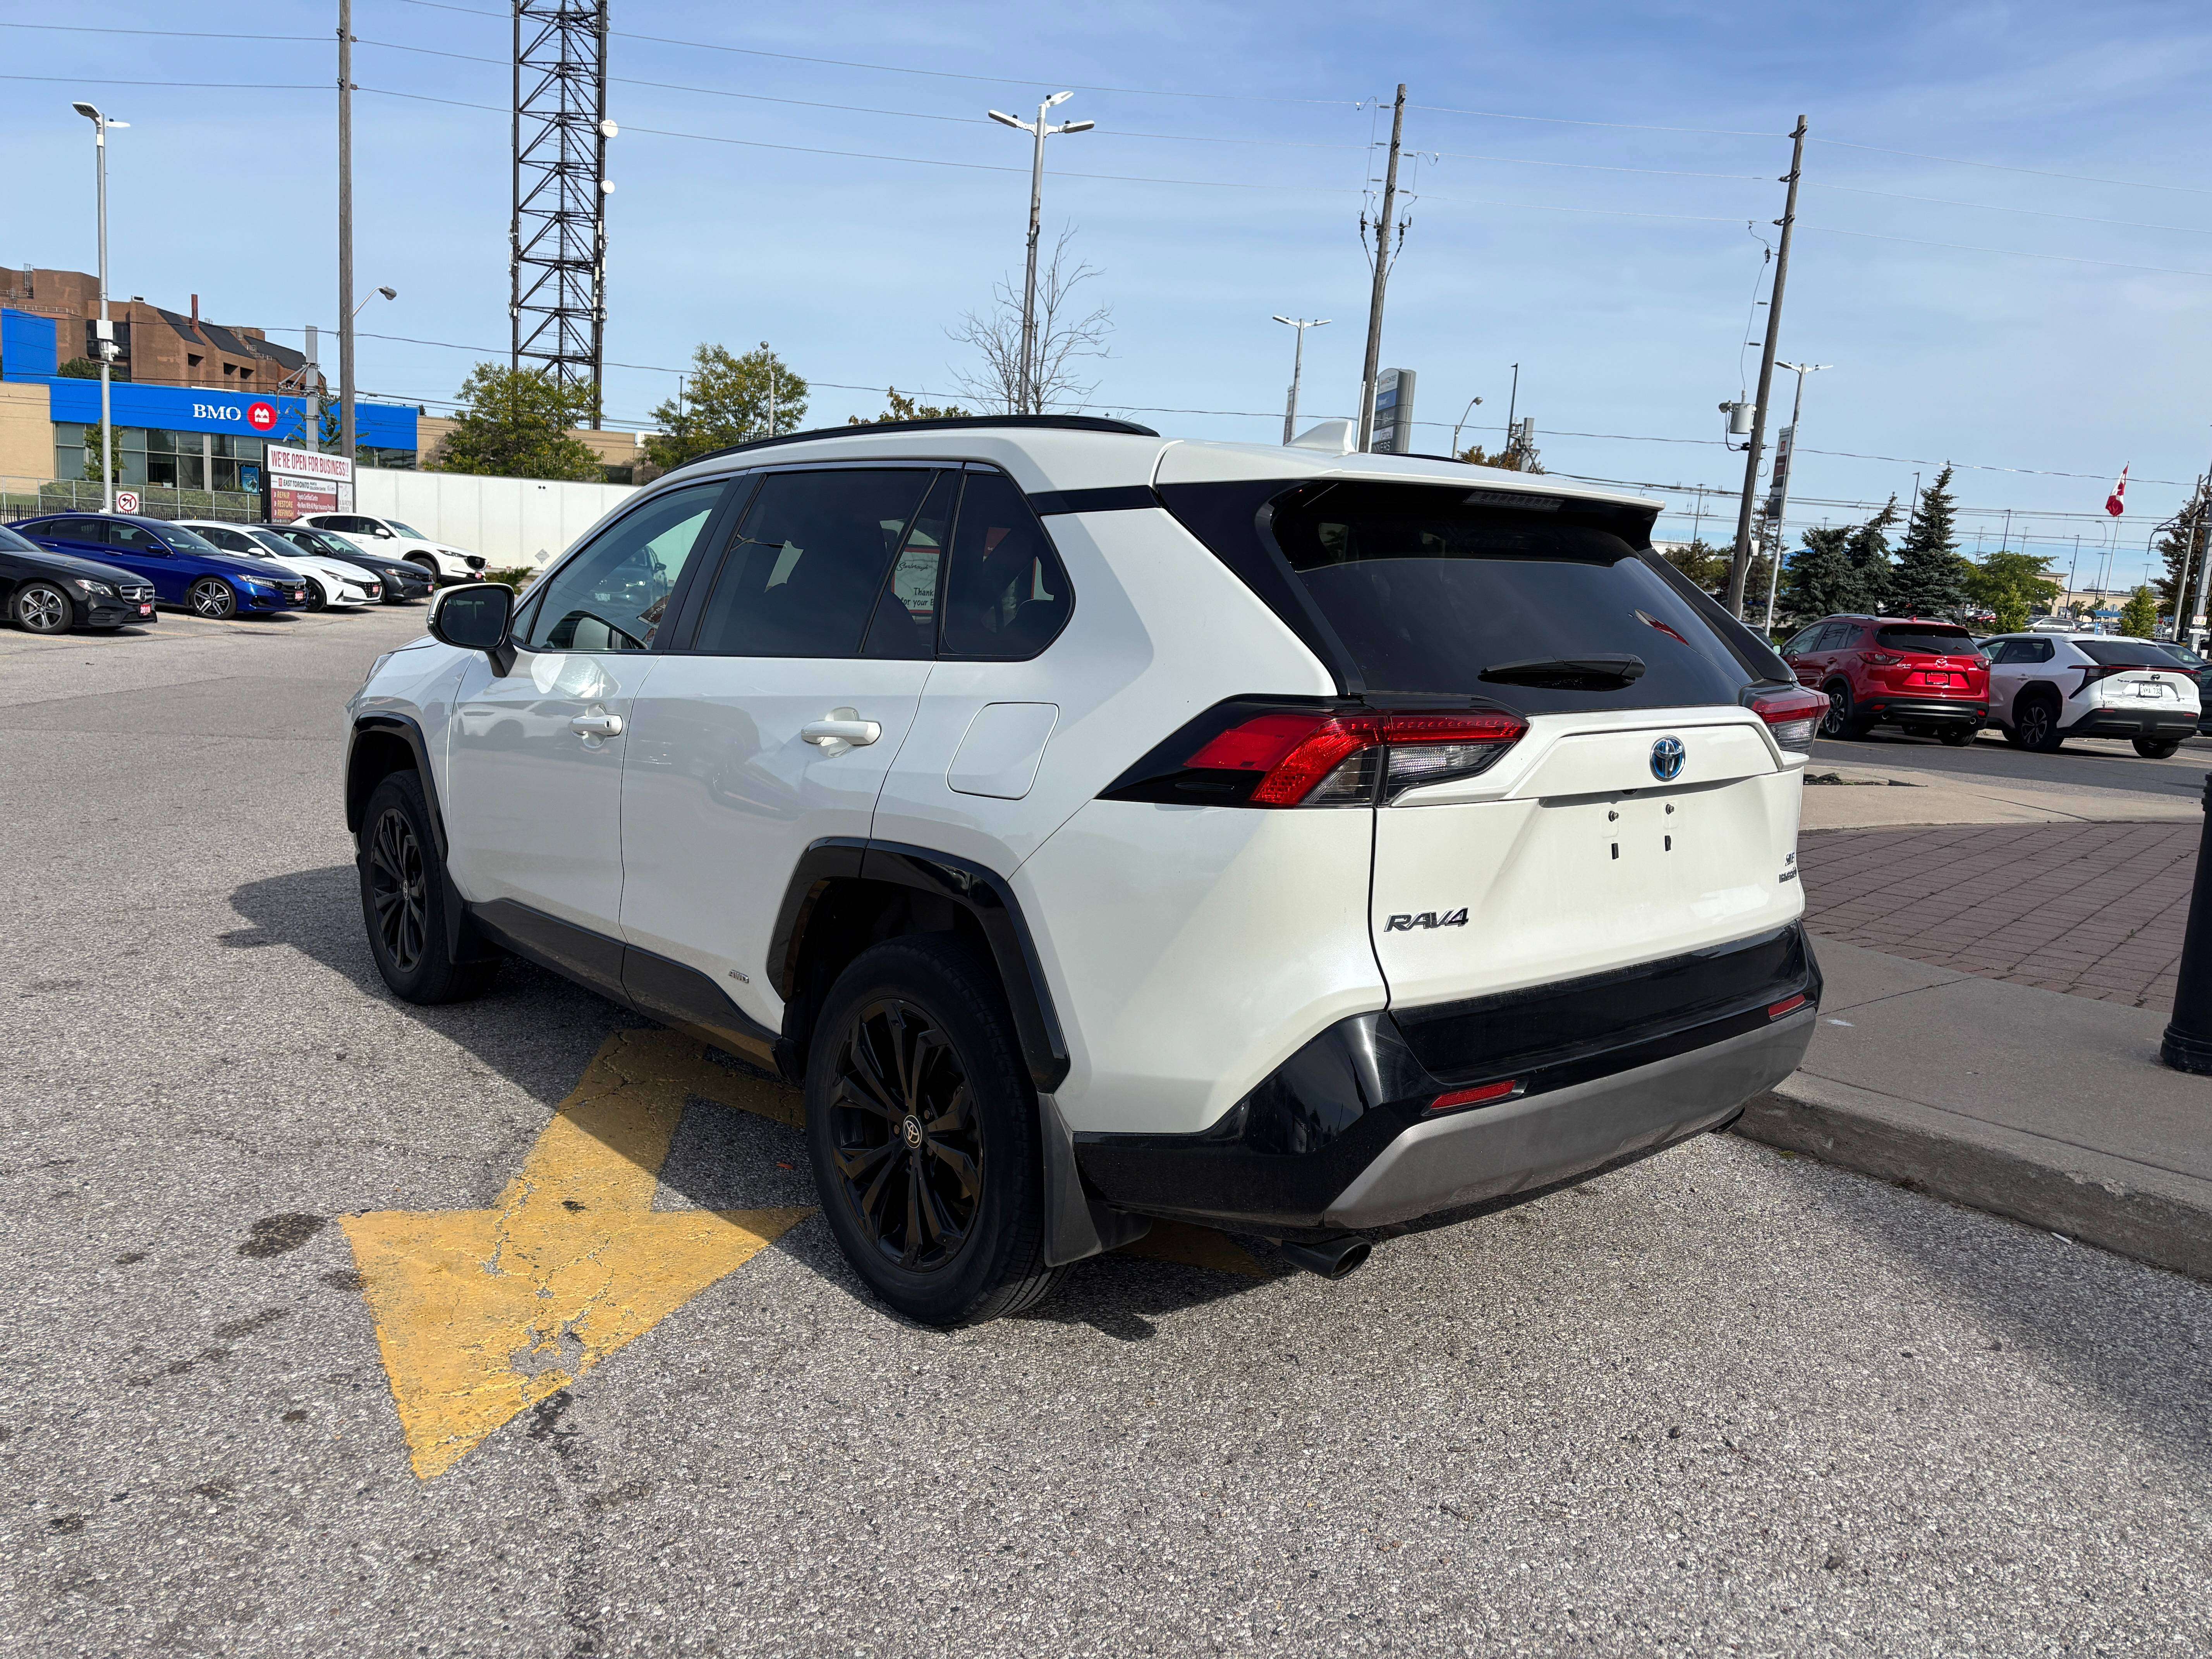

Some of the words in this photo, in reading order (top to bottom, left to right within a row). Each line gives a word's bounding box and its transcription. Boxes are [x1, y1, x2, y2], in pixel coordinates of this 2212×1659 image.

[192, 404, 241, 421] BMO
[271, 450, 290, 468] WE'RE
[292, 453, 307, 471] OPEN
[308, 456, 318, 472] FOR
[320, 458, 349, 477] BUSINESS!!
[292, 481, 309, 489] TORONTO
[896, 562, 929, 571] Scarborough
[914, 587, 934, 596] Thank
[913, 599, 928, 608] your
[1384, 906, 1469, 932] RAV4
